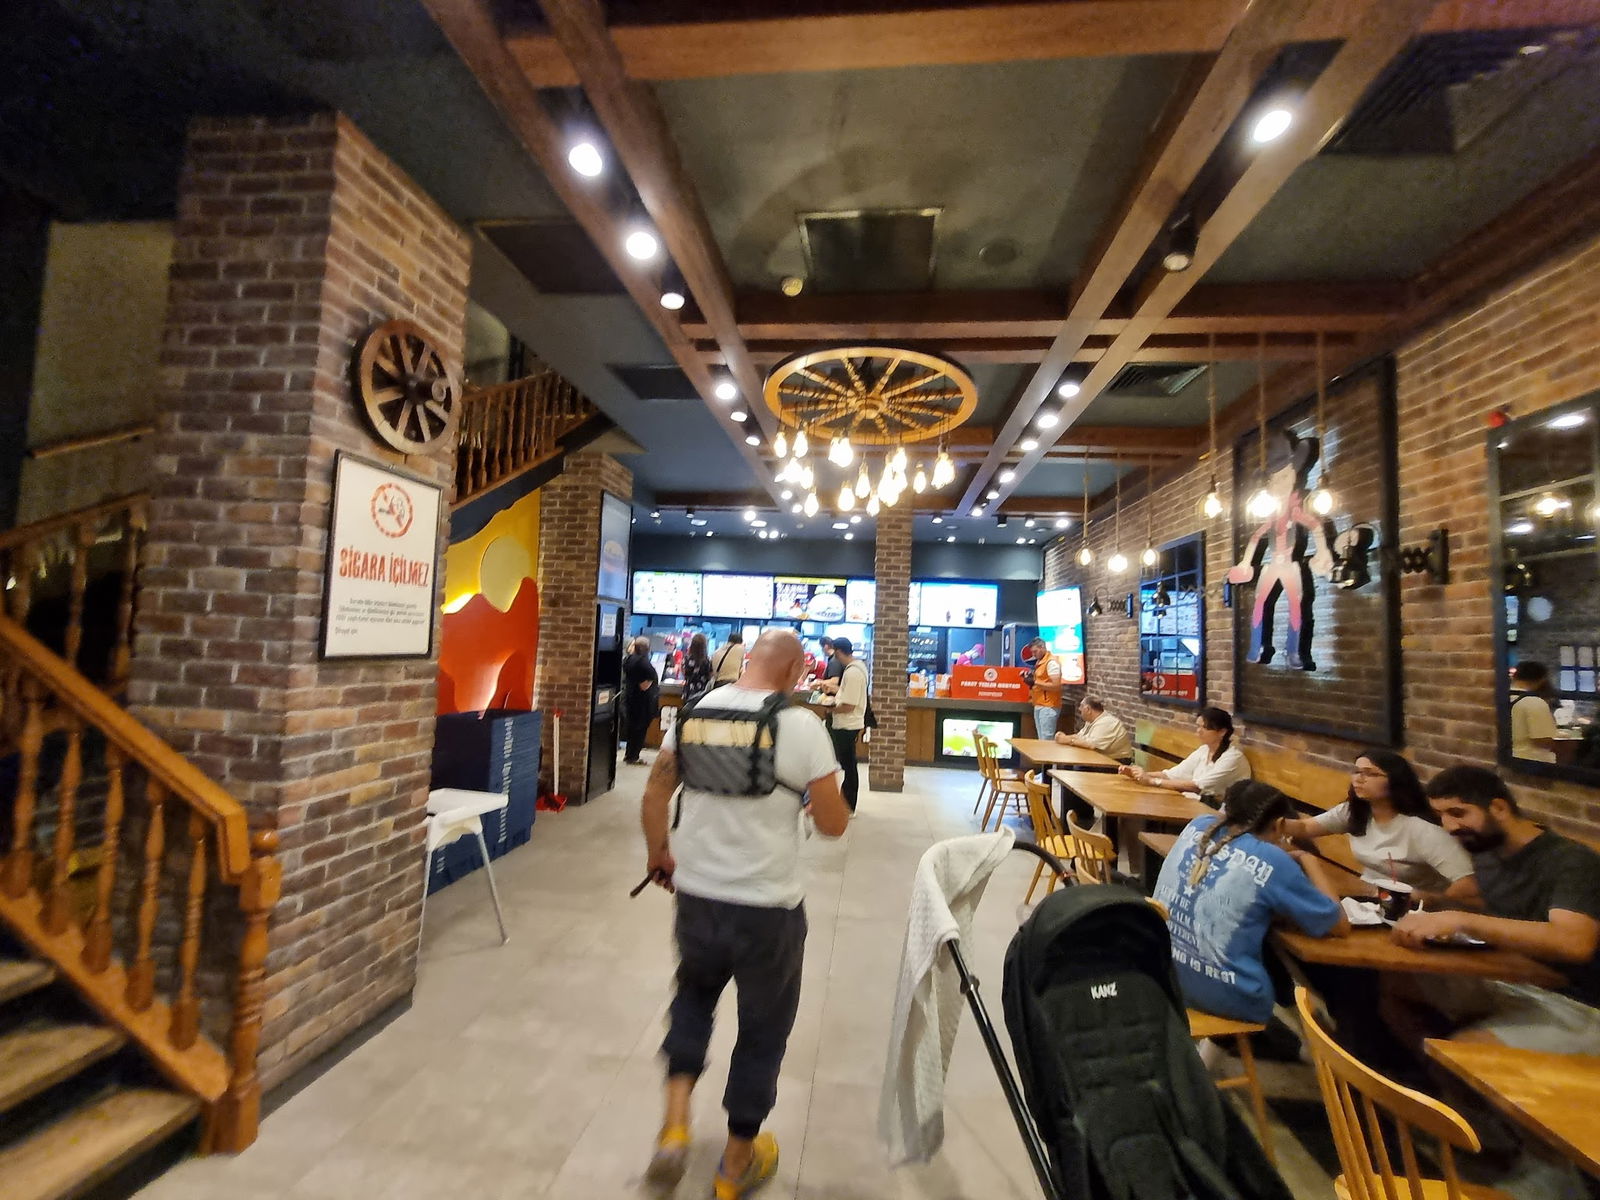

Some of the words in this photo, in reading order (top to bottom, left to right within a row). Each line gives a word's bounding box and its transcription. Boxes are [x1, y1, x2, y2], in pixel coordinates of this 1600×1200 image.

[339, 545, 386, 582] SİGARA
[389, 552, 430, 587] İÇİLMEZ
[1090, 981, 1118, 1000] KANZ
